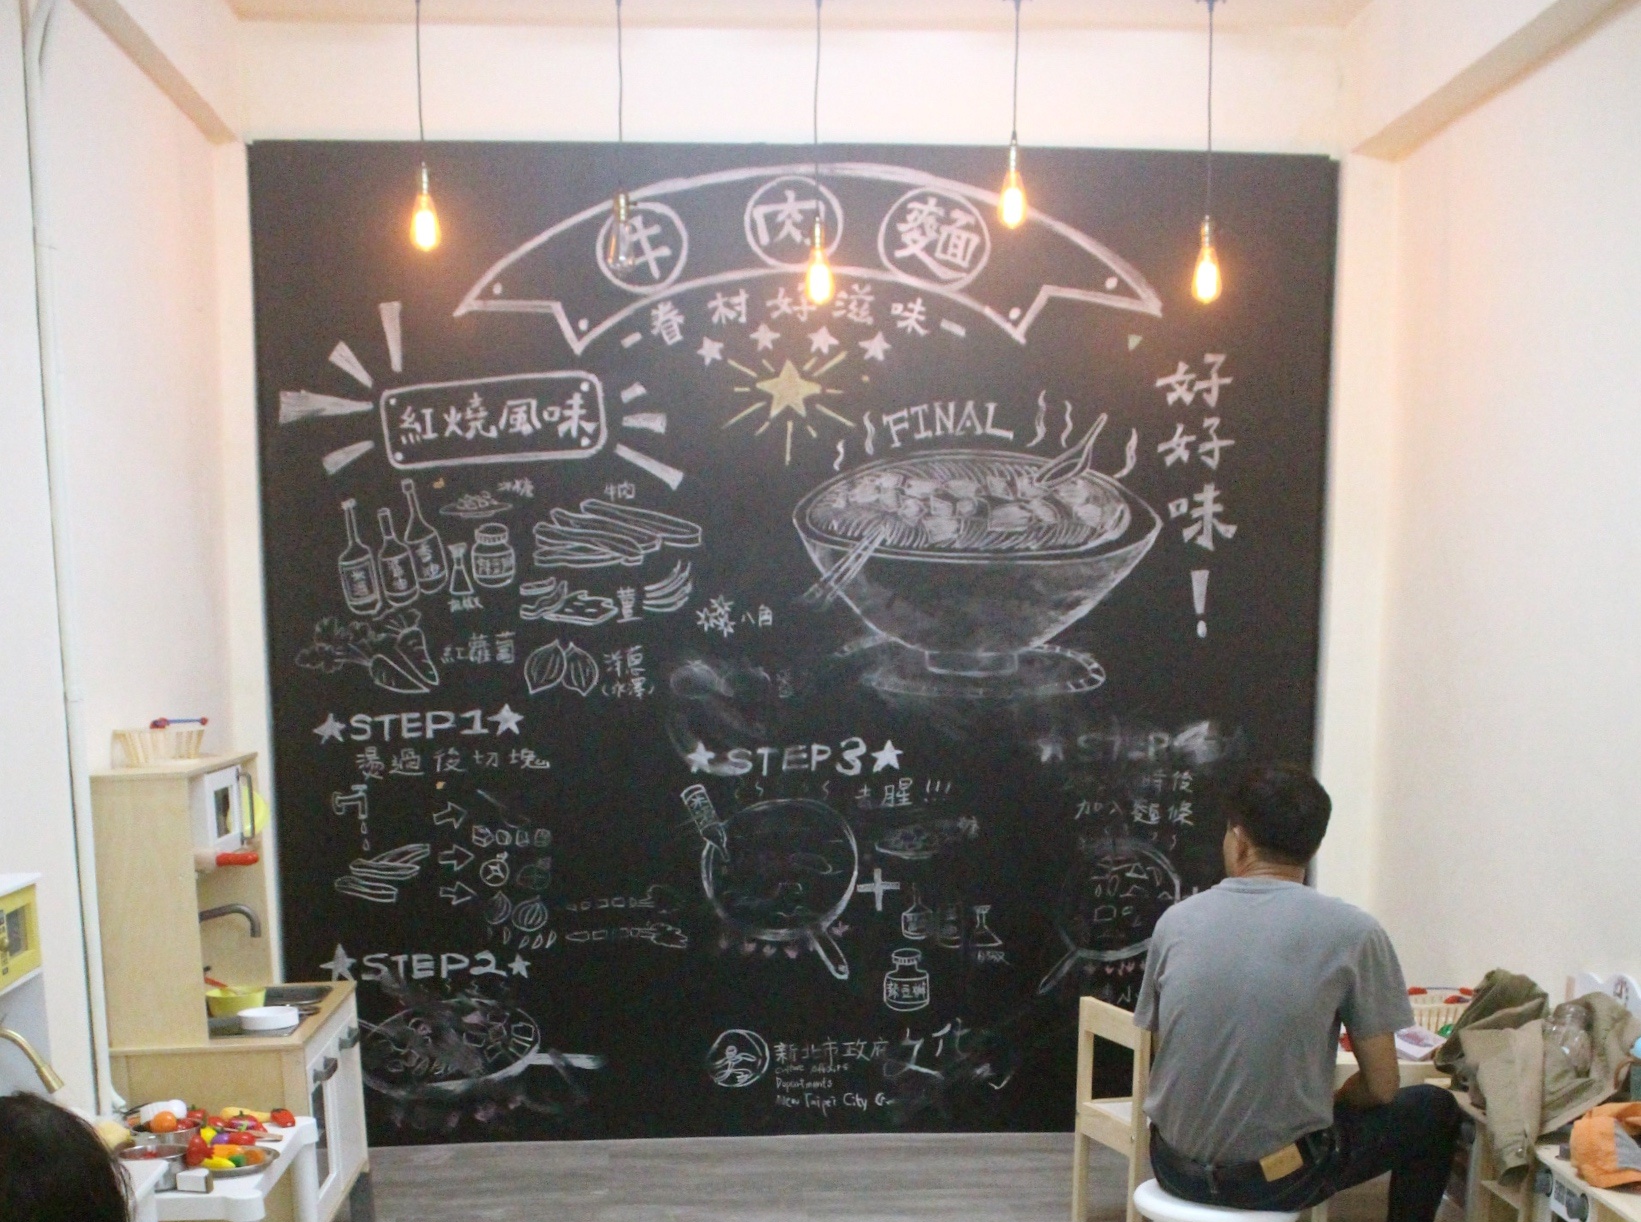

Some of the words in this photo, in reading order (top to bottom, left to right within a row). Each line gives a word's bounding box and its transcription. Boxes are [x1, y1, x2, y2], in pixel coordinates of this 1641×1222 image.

[398, 391, 598, 446] 紅燒風味
[882, 401, 1014, 448] FINAL
[603, 480, 636, 502] 牛肉
[741, 604, 773, 627] 八角
[440, 631, 516, 664] 紅蘿蔔
[348, 709, 489, 742] STEP1
[361, 948, 508, 982] STEP2
[773, 1036, 889, 1066] 新北市政府
[843, 1092, 868, 1112] City
